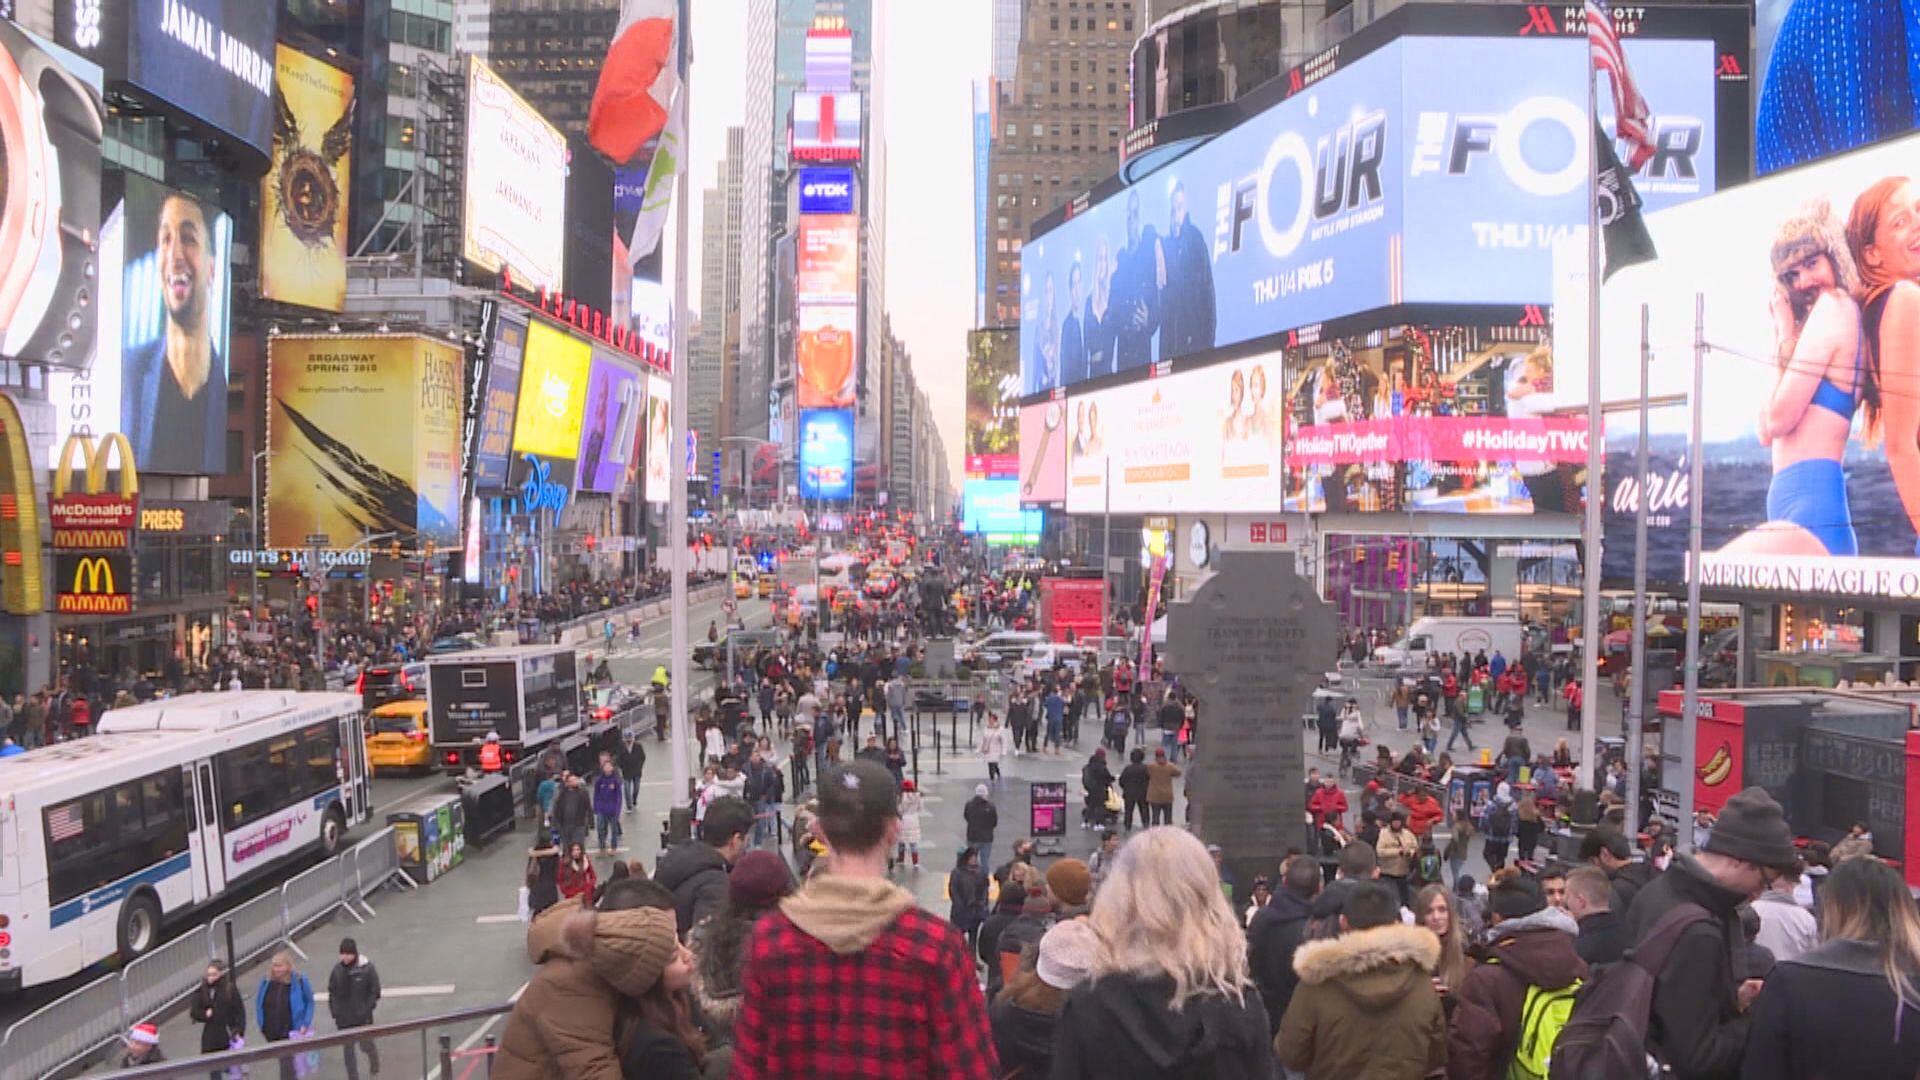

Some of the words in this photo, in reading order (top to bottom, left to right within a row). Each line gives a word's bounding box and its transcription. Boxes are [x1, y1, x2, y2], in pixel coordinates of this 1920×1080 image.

[1565, 8, 1645, 20] MAOTT
[1565, 22, 1636, 34] MAIS
[160, 3, 216, 61] JAMAL
[219, 30, 272, 98] MURRAY
[1304, 45, 1340, 70] MARRIOTT
[1304, 61, 1336, 84] MARQUIS
[793, 147, 861, 160] TOSHIBA
[1449, 97, 1704, 195] FOR
[815, 184, 848, 196] TDK
[1231, 112, 1387, 257] FOUR
[1472, 222, 1533, 249] THU
[1253, 276, 1278, 304] THU
[1280, 271, 1296, 297] 1/4
[1298, 262, 1322, 292] FOX
[1323, 257, 1334, 285] 5
[306, 364, 349, 373] SPRING
[308, 353, 376, 363] BROADWAY
[1296, 431, 1387, 457] #HolidayTWOgether
[1462, 428, 1605, 455] #HolidayTW
[52, 504, 133, 516] McDonald's
[65, 517, 119, 525] Restaurant
[141, 510, 184, 531] PRESS
[292, 551, 368, 564] LGAG
[1702, 563, 1802, 592] MERICAN
[1812, 567, 1892, 598] EAGLE
